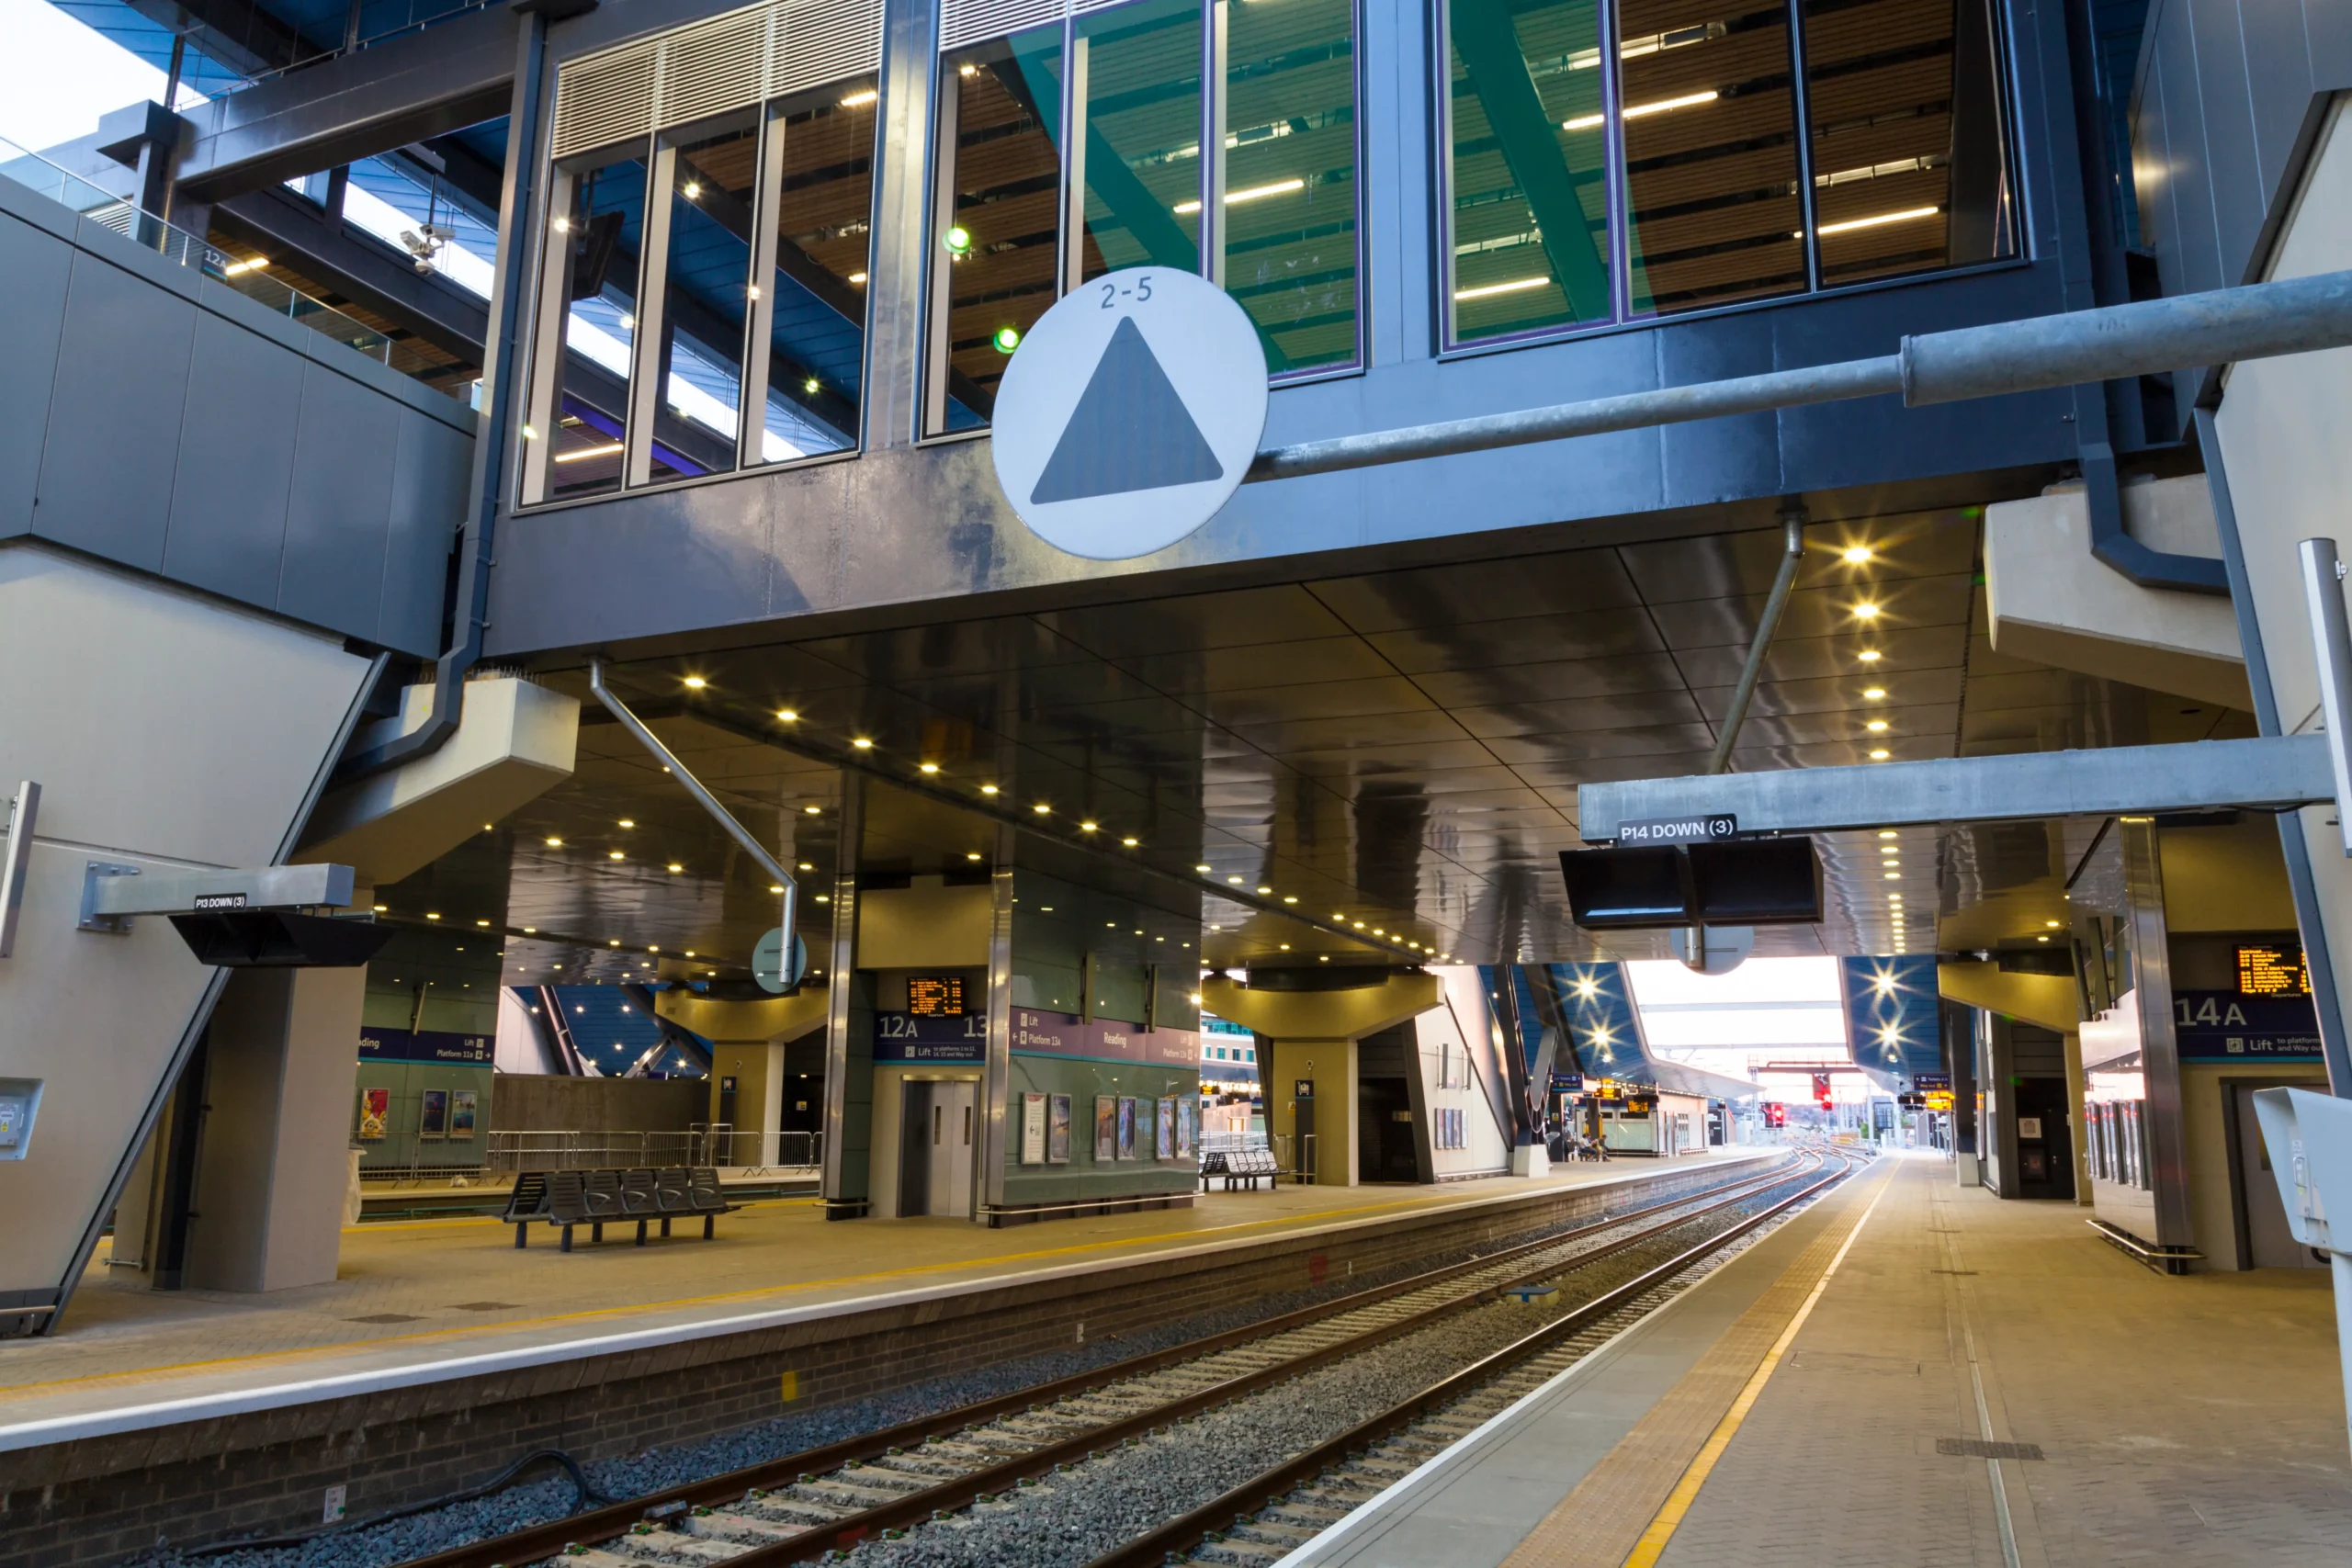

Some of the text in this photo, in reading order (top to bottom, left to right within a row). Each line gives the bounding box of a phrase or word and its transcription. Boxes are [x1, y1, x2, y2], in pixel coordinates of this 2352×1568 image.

[205, 250, 226, 269] 12A
[1101, 276, 1152, 310] 2-5
[1622, 818, 1734, 840] P14 DOWN (3)
[196, 896, 245, 908] P13 DOWN (3)
[2175, 998, 2247, 1026] 14A
[879, 1016, 918, 1038] 12A
[1029, 1015, 1038, 1027] Lift
[1028, 1033, 1051, 1045] Platform
[1103, 1032, 1127, 1048] Reading
[2250, 1040, 2273, 1051] Lift
[2293, 1044, 2309, 1053] Way
[436, 1049, 462, 1057] Platform
[919, 1048, 932, 1056] Lift
